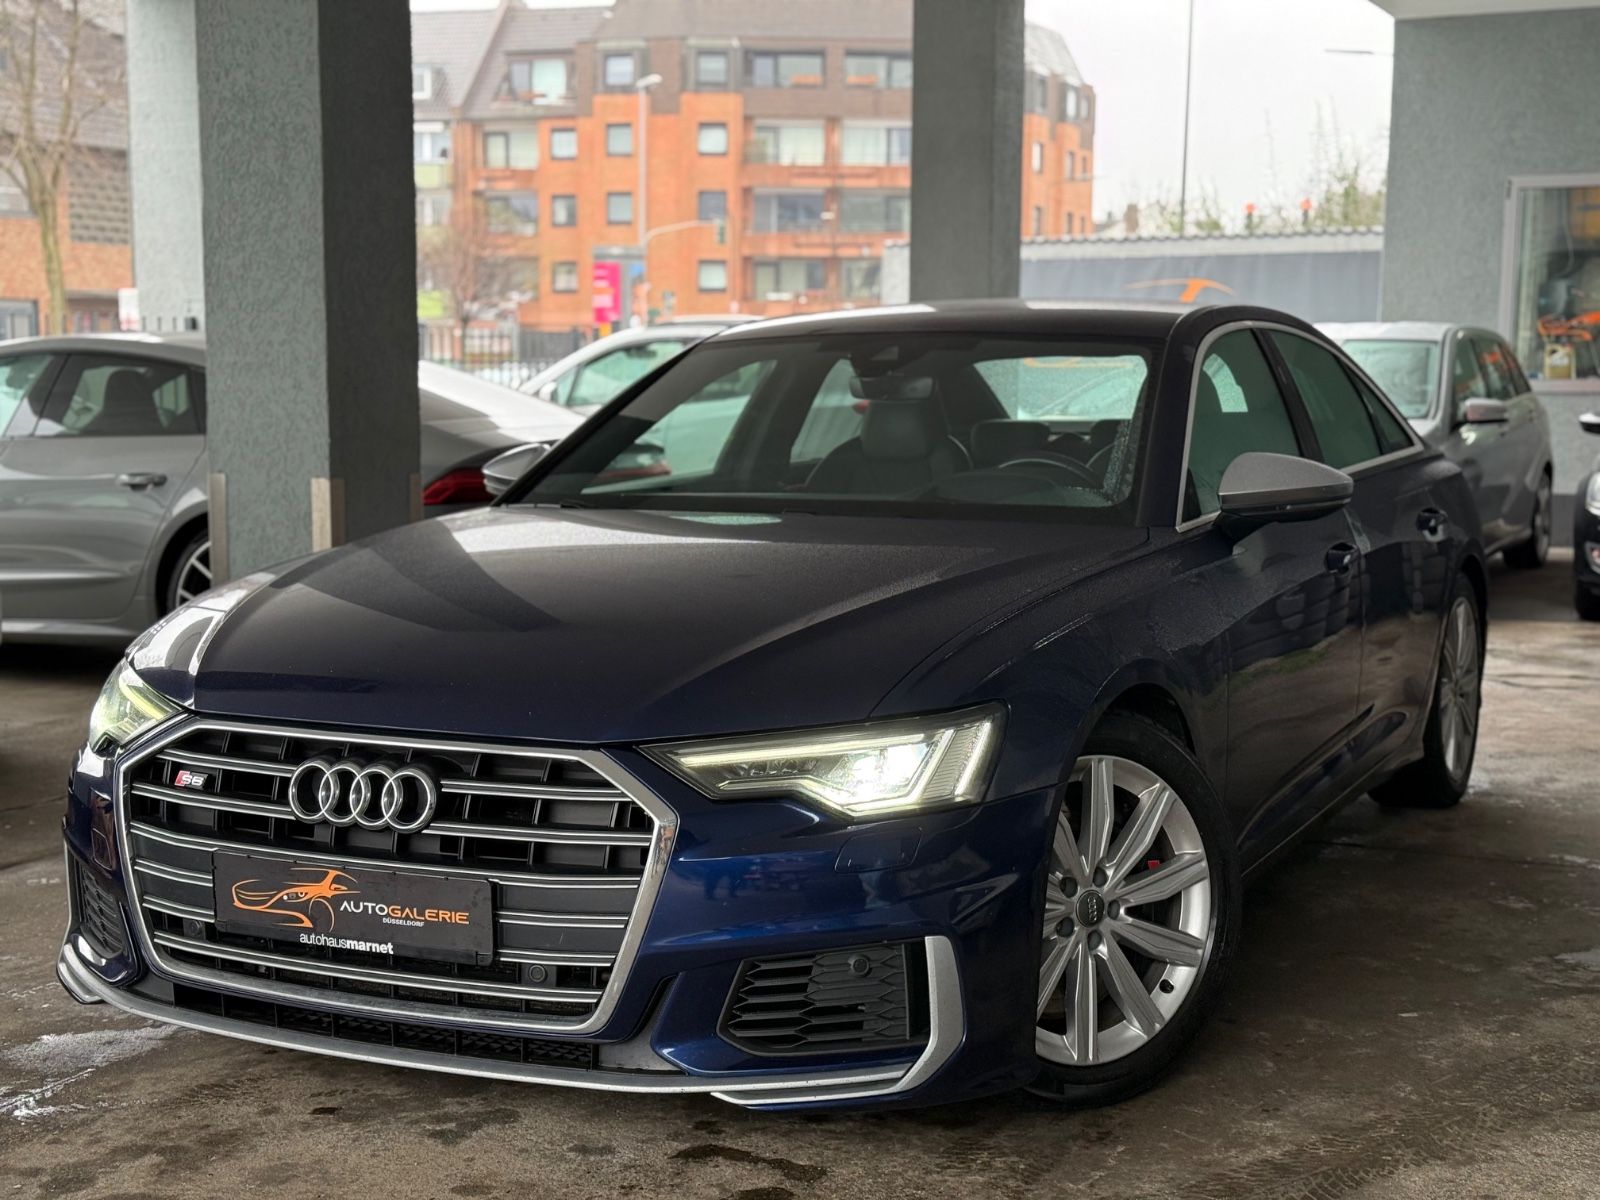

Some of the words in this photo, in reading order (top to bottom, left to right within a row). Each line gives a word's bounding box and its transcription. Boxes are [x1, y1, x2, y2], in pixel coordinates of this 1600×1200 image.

[181, 774, 205, 786] S6
[340, 900, 470, 925] AUTOGALERIE
[382, 917, 425, 928] DÜSSELDORF
[299, 932, 394, 955] autohausmarnet
